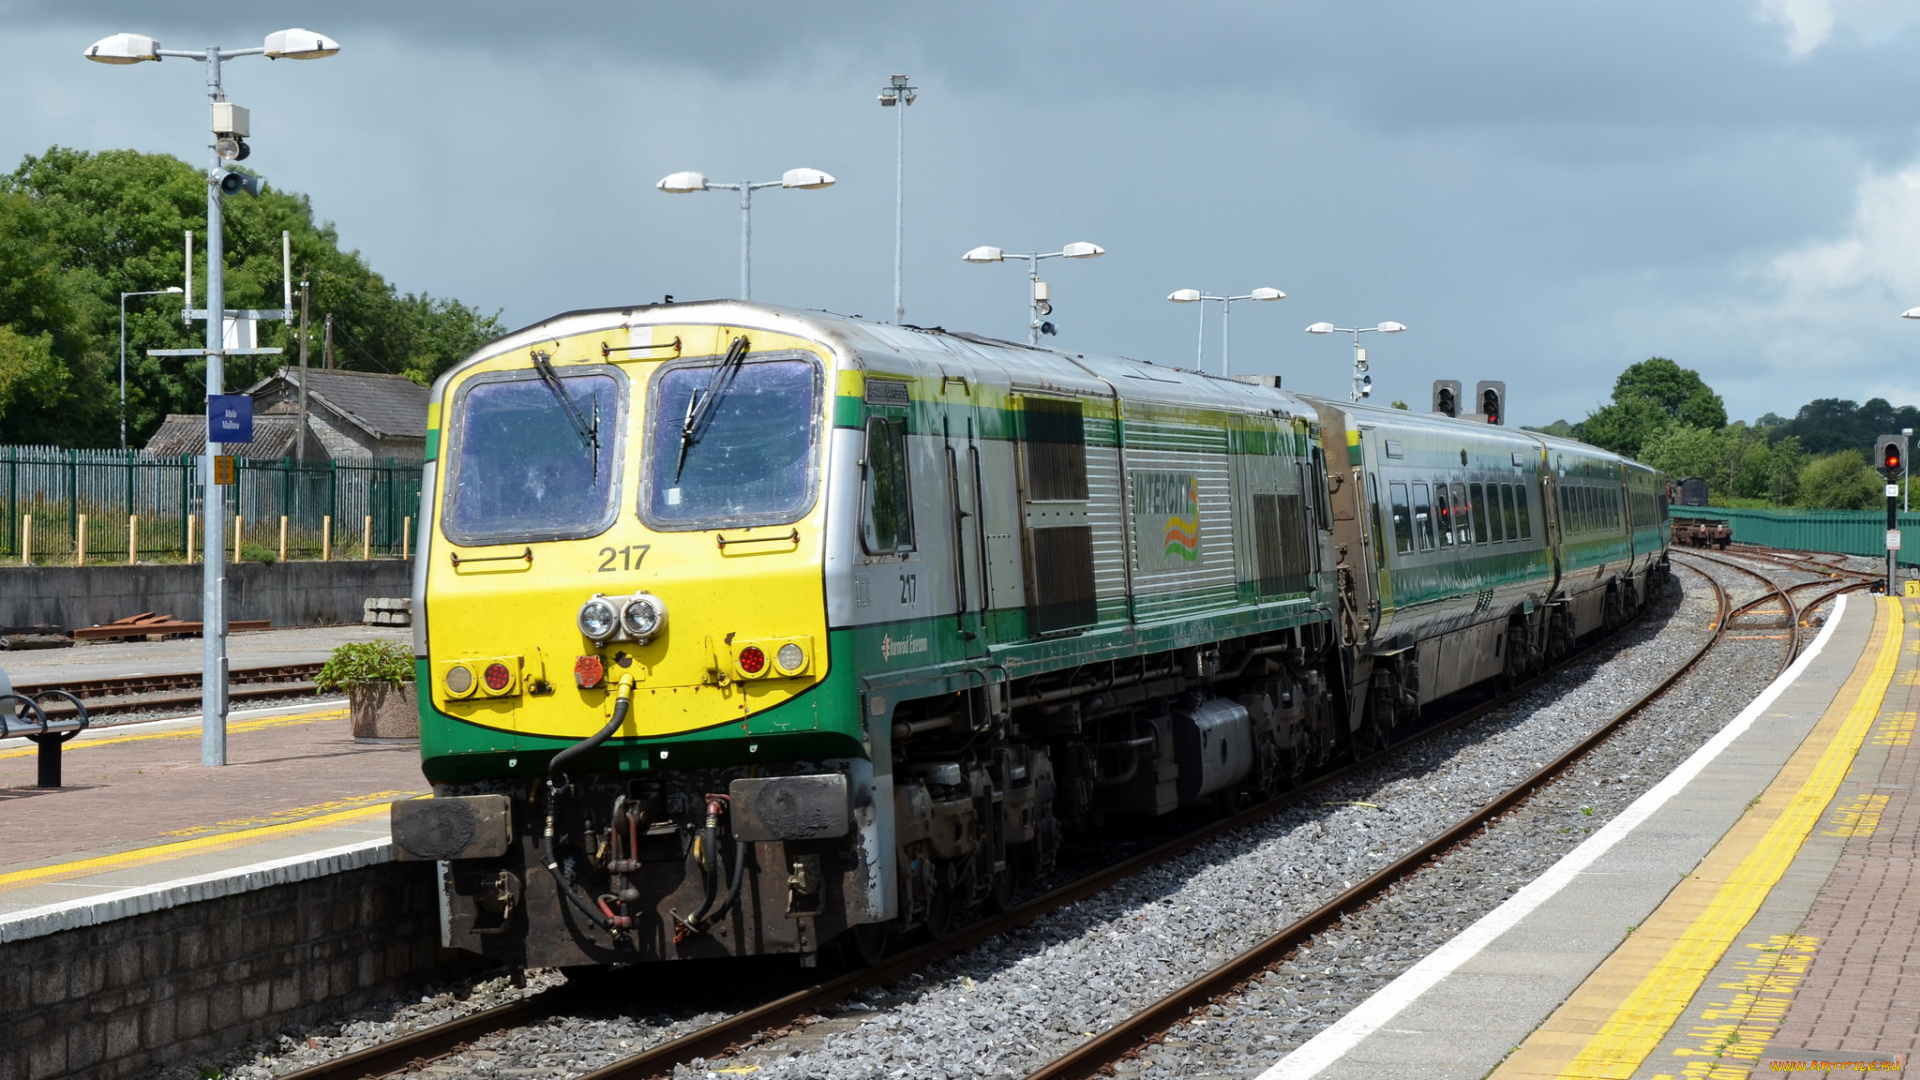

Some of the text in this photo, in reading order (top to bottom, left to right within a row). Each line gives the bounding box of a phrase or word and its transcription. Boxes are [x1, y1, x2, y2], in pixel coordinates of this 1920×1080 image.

[222, 420, 240, 430] Mallow
[1135, 473, 1192, 514] INTERCITY
[598, 544, 651, 572] 217
[899, 574, 916, 604] 217
